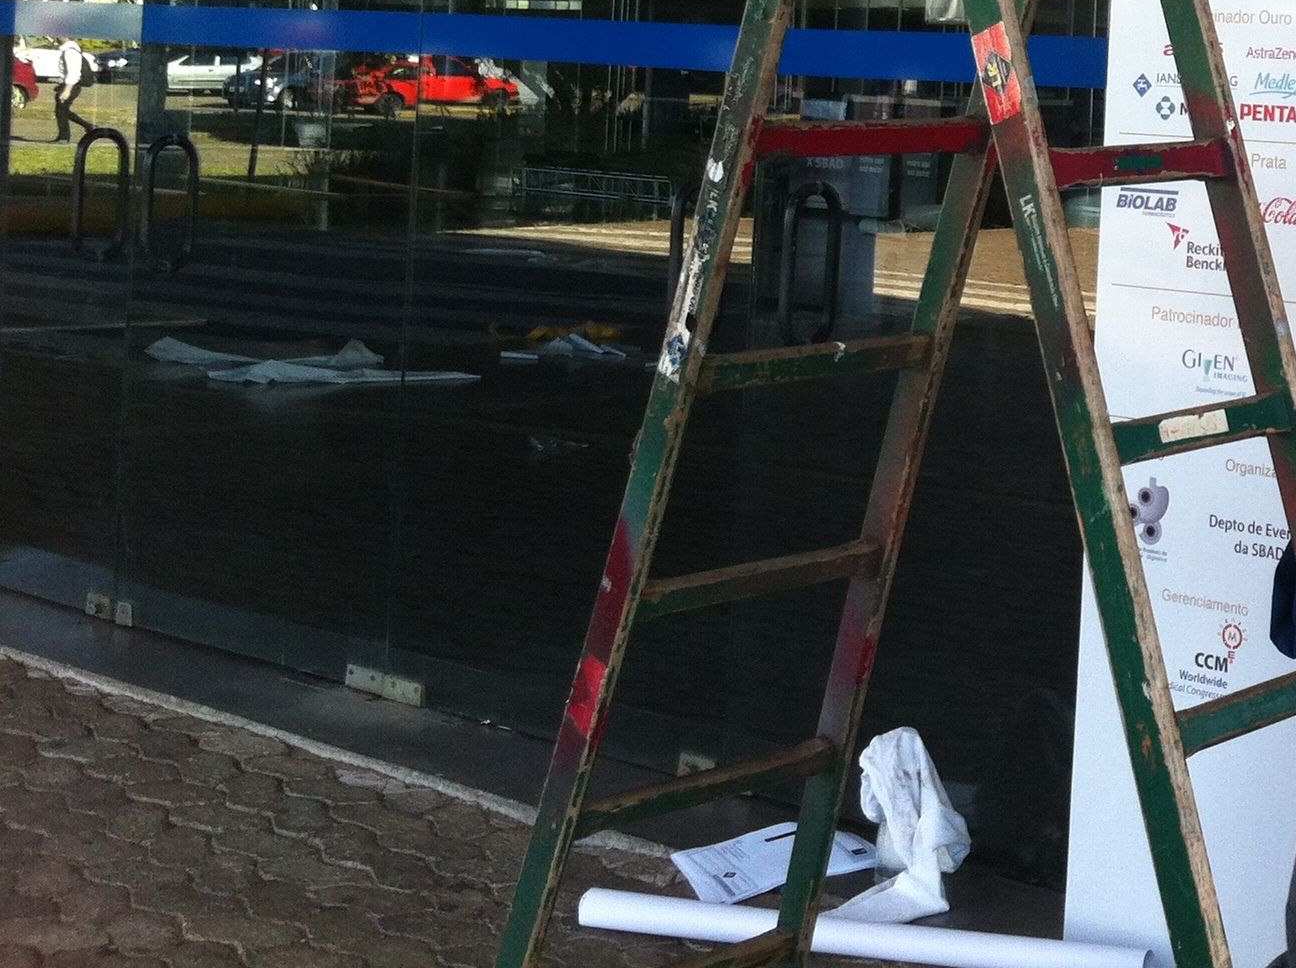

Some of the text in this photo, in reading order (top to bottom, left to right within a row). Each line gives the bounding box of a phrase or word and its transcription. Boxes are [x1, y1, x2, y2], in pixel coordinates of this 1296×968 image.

[1258, 10, 1293, 25] Ouro
[1251, 153, 1287, 170] Prata
[1151, 305, 1234, 328] Patrocinador
[1213, 372, 1248, 383] IMAGING
[1209, 514, 1245, 533] Depto
[1247, 520, 1263, 534] de
[1234, 540, 1249, 555] da
[1162, 588, 1249, 617] Gerenciamento
[1194, 652, 1229, 672] CCM
[1179, 669, 1228, 689] Worldwide
